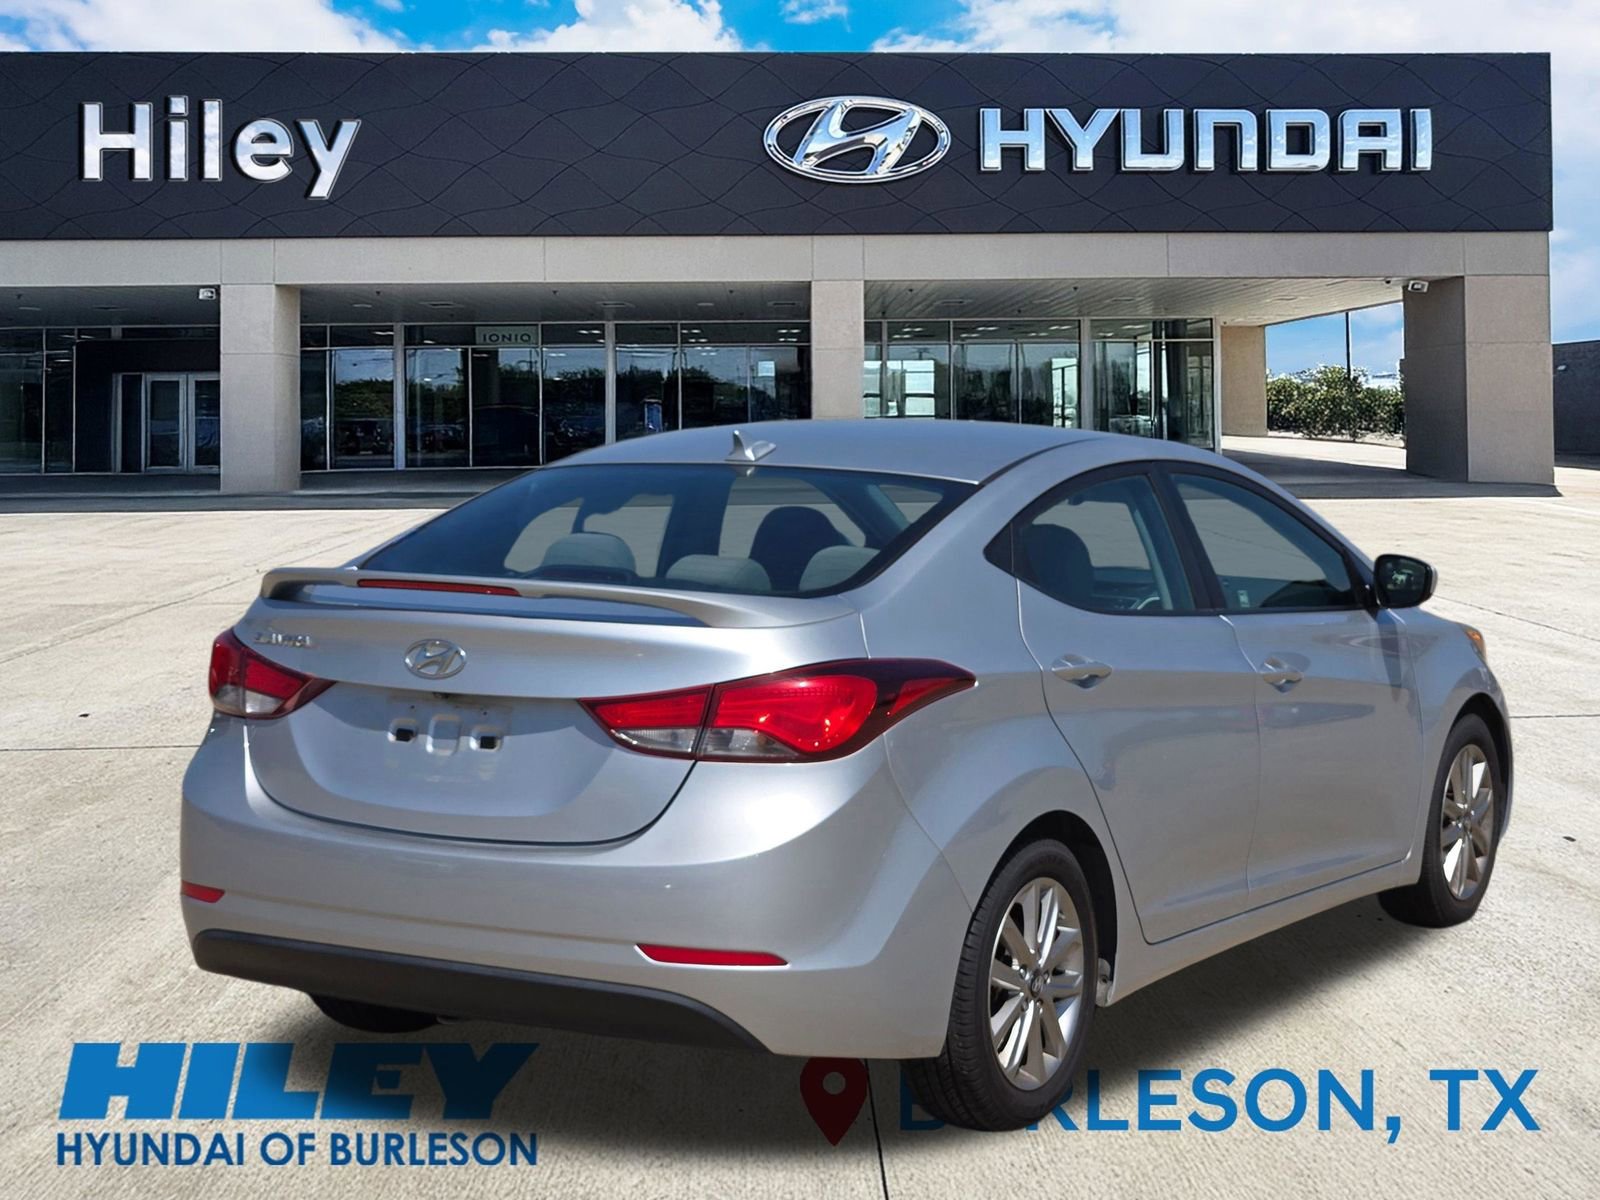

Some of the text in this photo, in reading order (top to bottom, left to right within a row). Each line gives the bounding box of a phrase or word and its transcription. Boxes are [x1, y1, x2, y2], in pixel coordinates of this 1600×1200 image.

[80, 95, 362, 200] Hiley
[980, 107, 1433, 173] HYUNDAI
[482, 332, 532, 343] IONIQ
